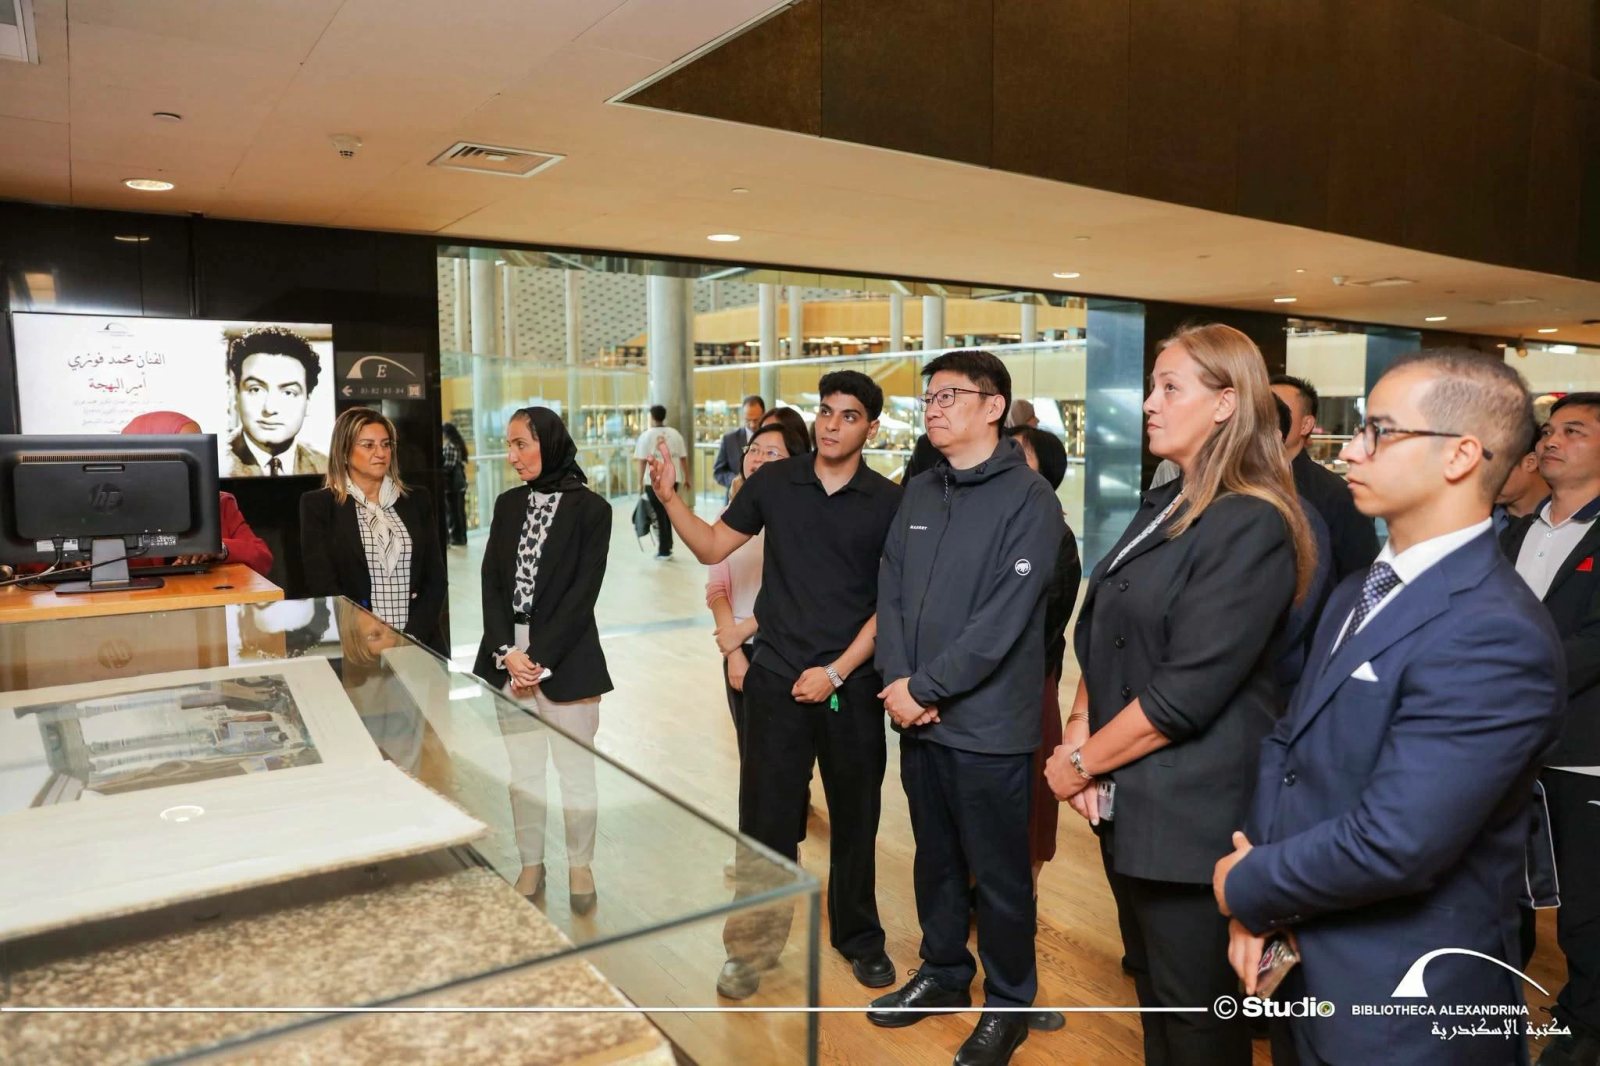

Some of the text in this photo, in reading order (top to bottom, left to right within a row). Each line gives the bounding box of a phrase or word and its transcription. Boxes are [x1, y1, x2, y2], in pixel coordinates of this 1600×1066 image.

[68, 350, 165, 371] الفنان محمد فوزي
[376, 364, 387, 378] E
[88, 371, 147, 396] أمير البهجة
